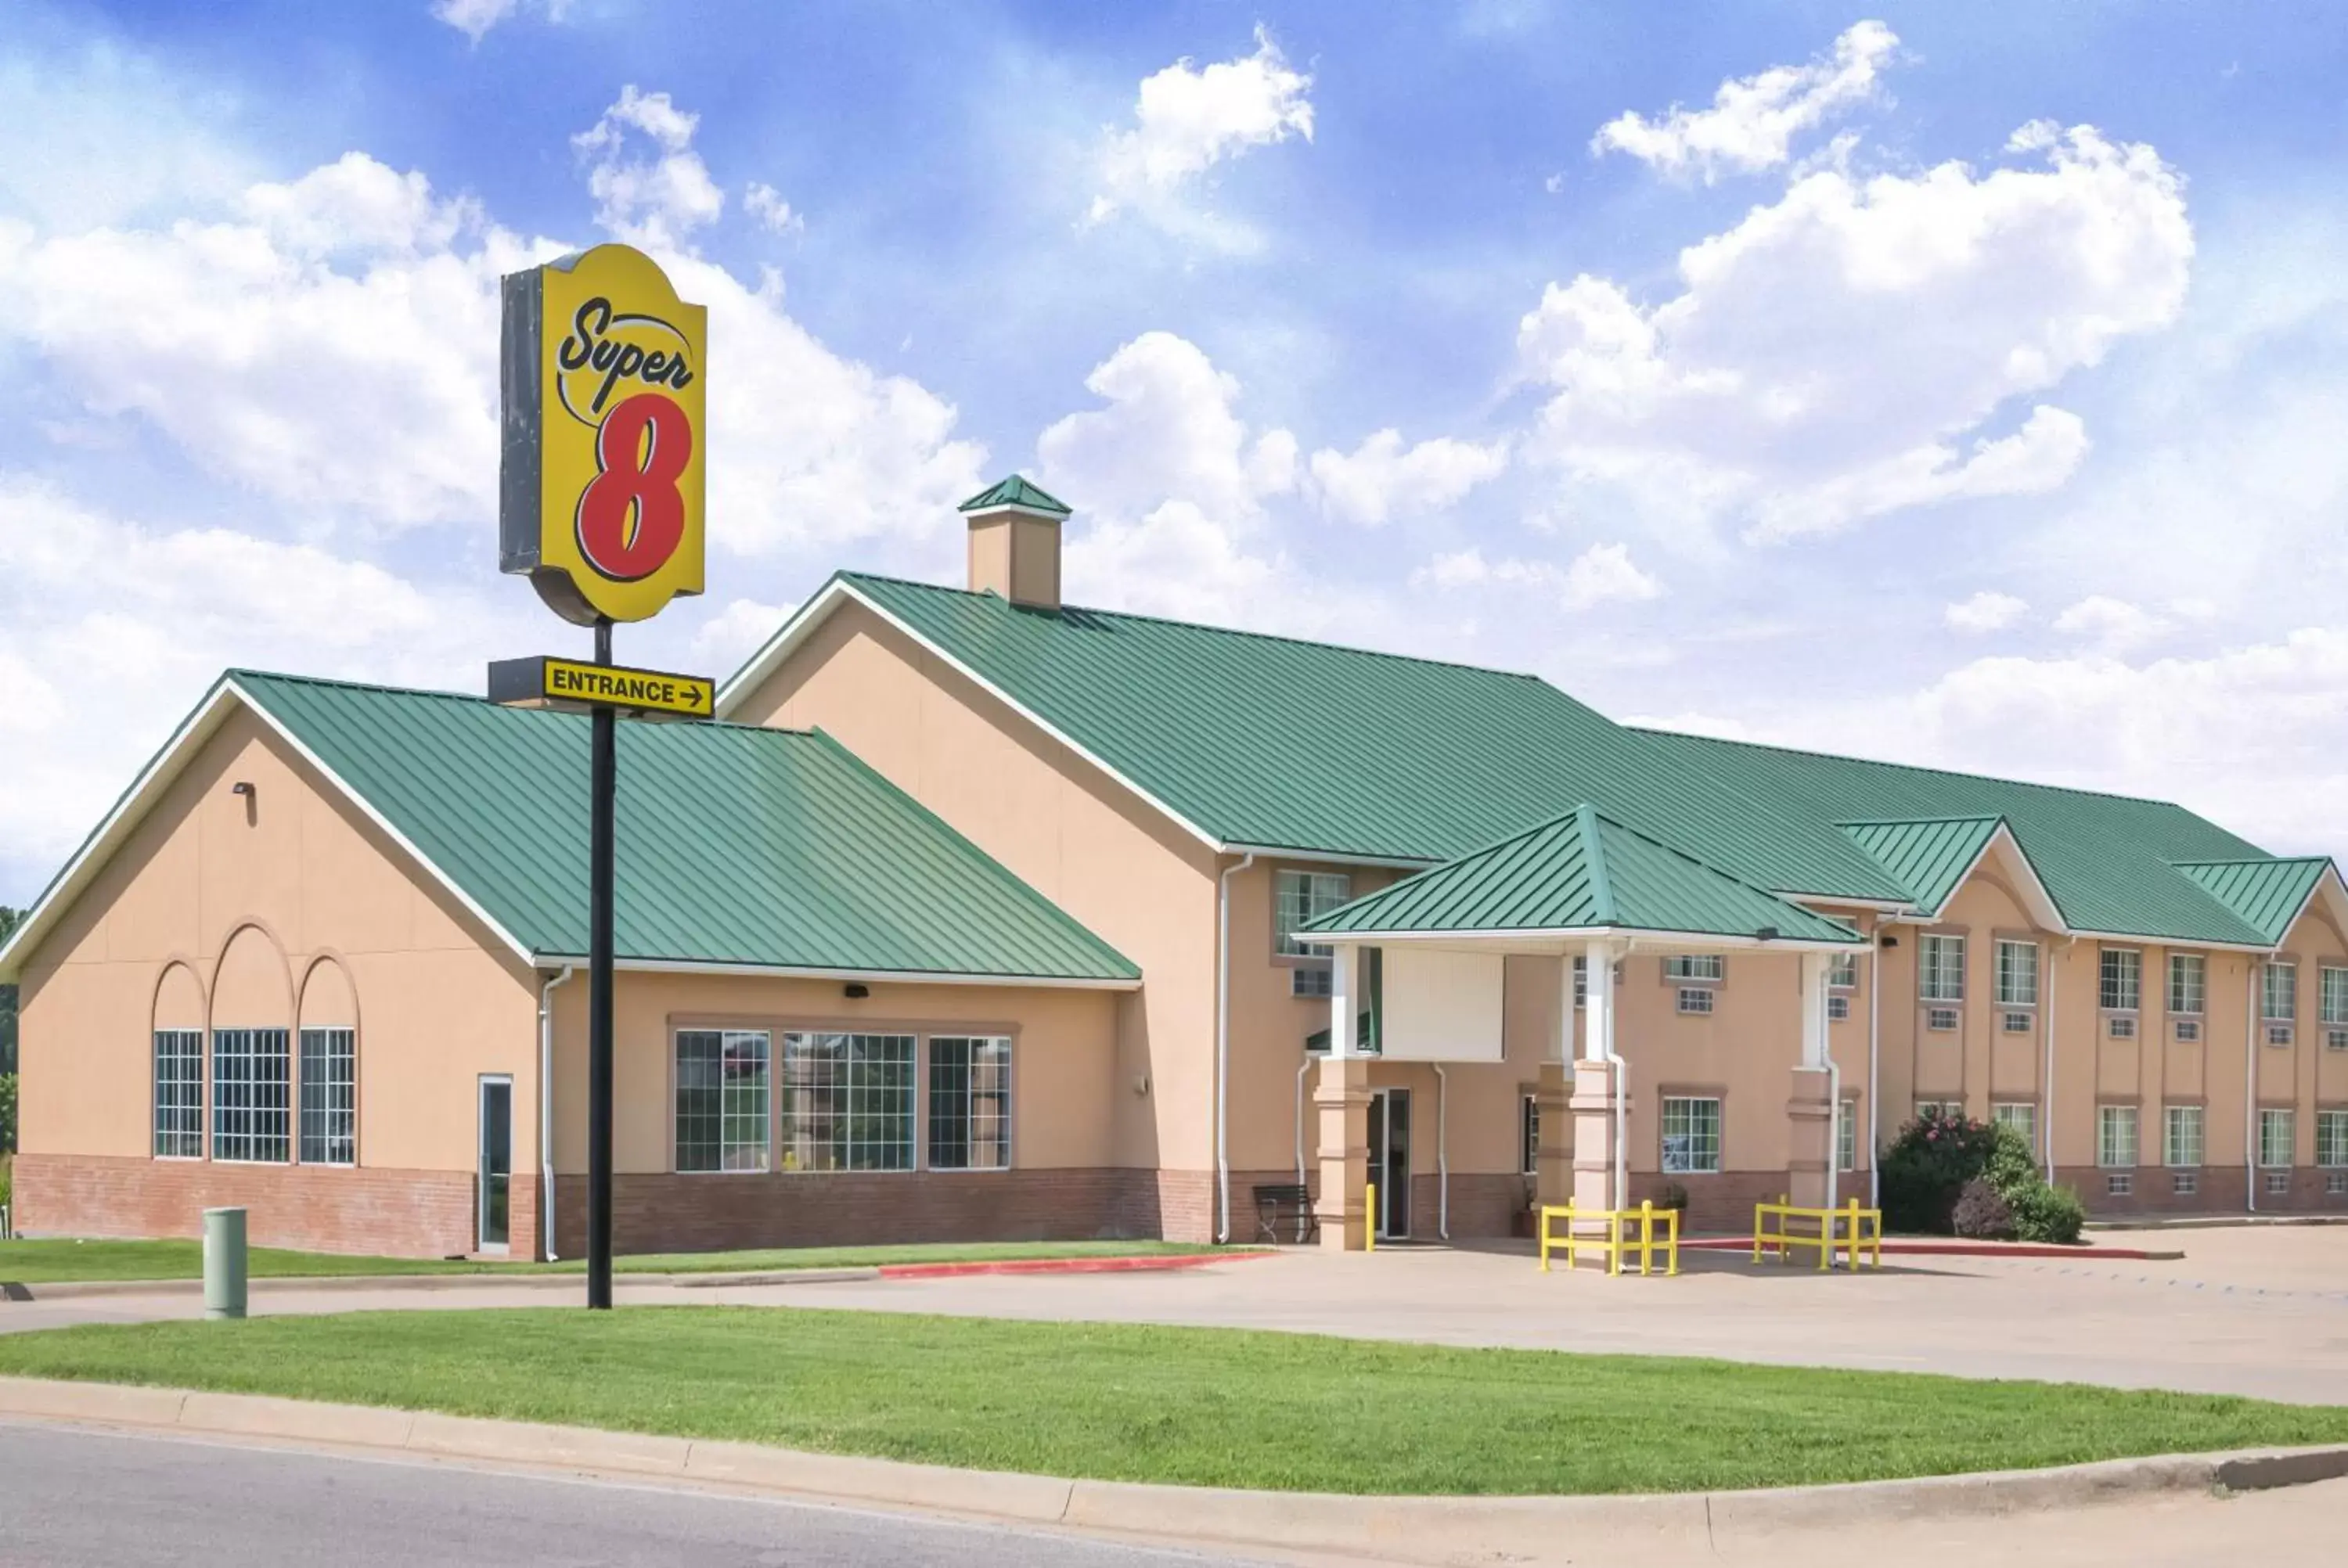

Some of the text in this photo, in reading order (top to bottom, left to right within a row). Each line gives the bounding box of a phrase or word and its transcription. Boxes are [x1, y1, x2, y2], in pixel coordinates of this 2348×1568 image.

[559, 297, 693, 414] Super
[574, 393, 693, 583] 8
[553, 669, 675, 703] ENTRANCE
